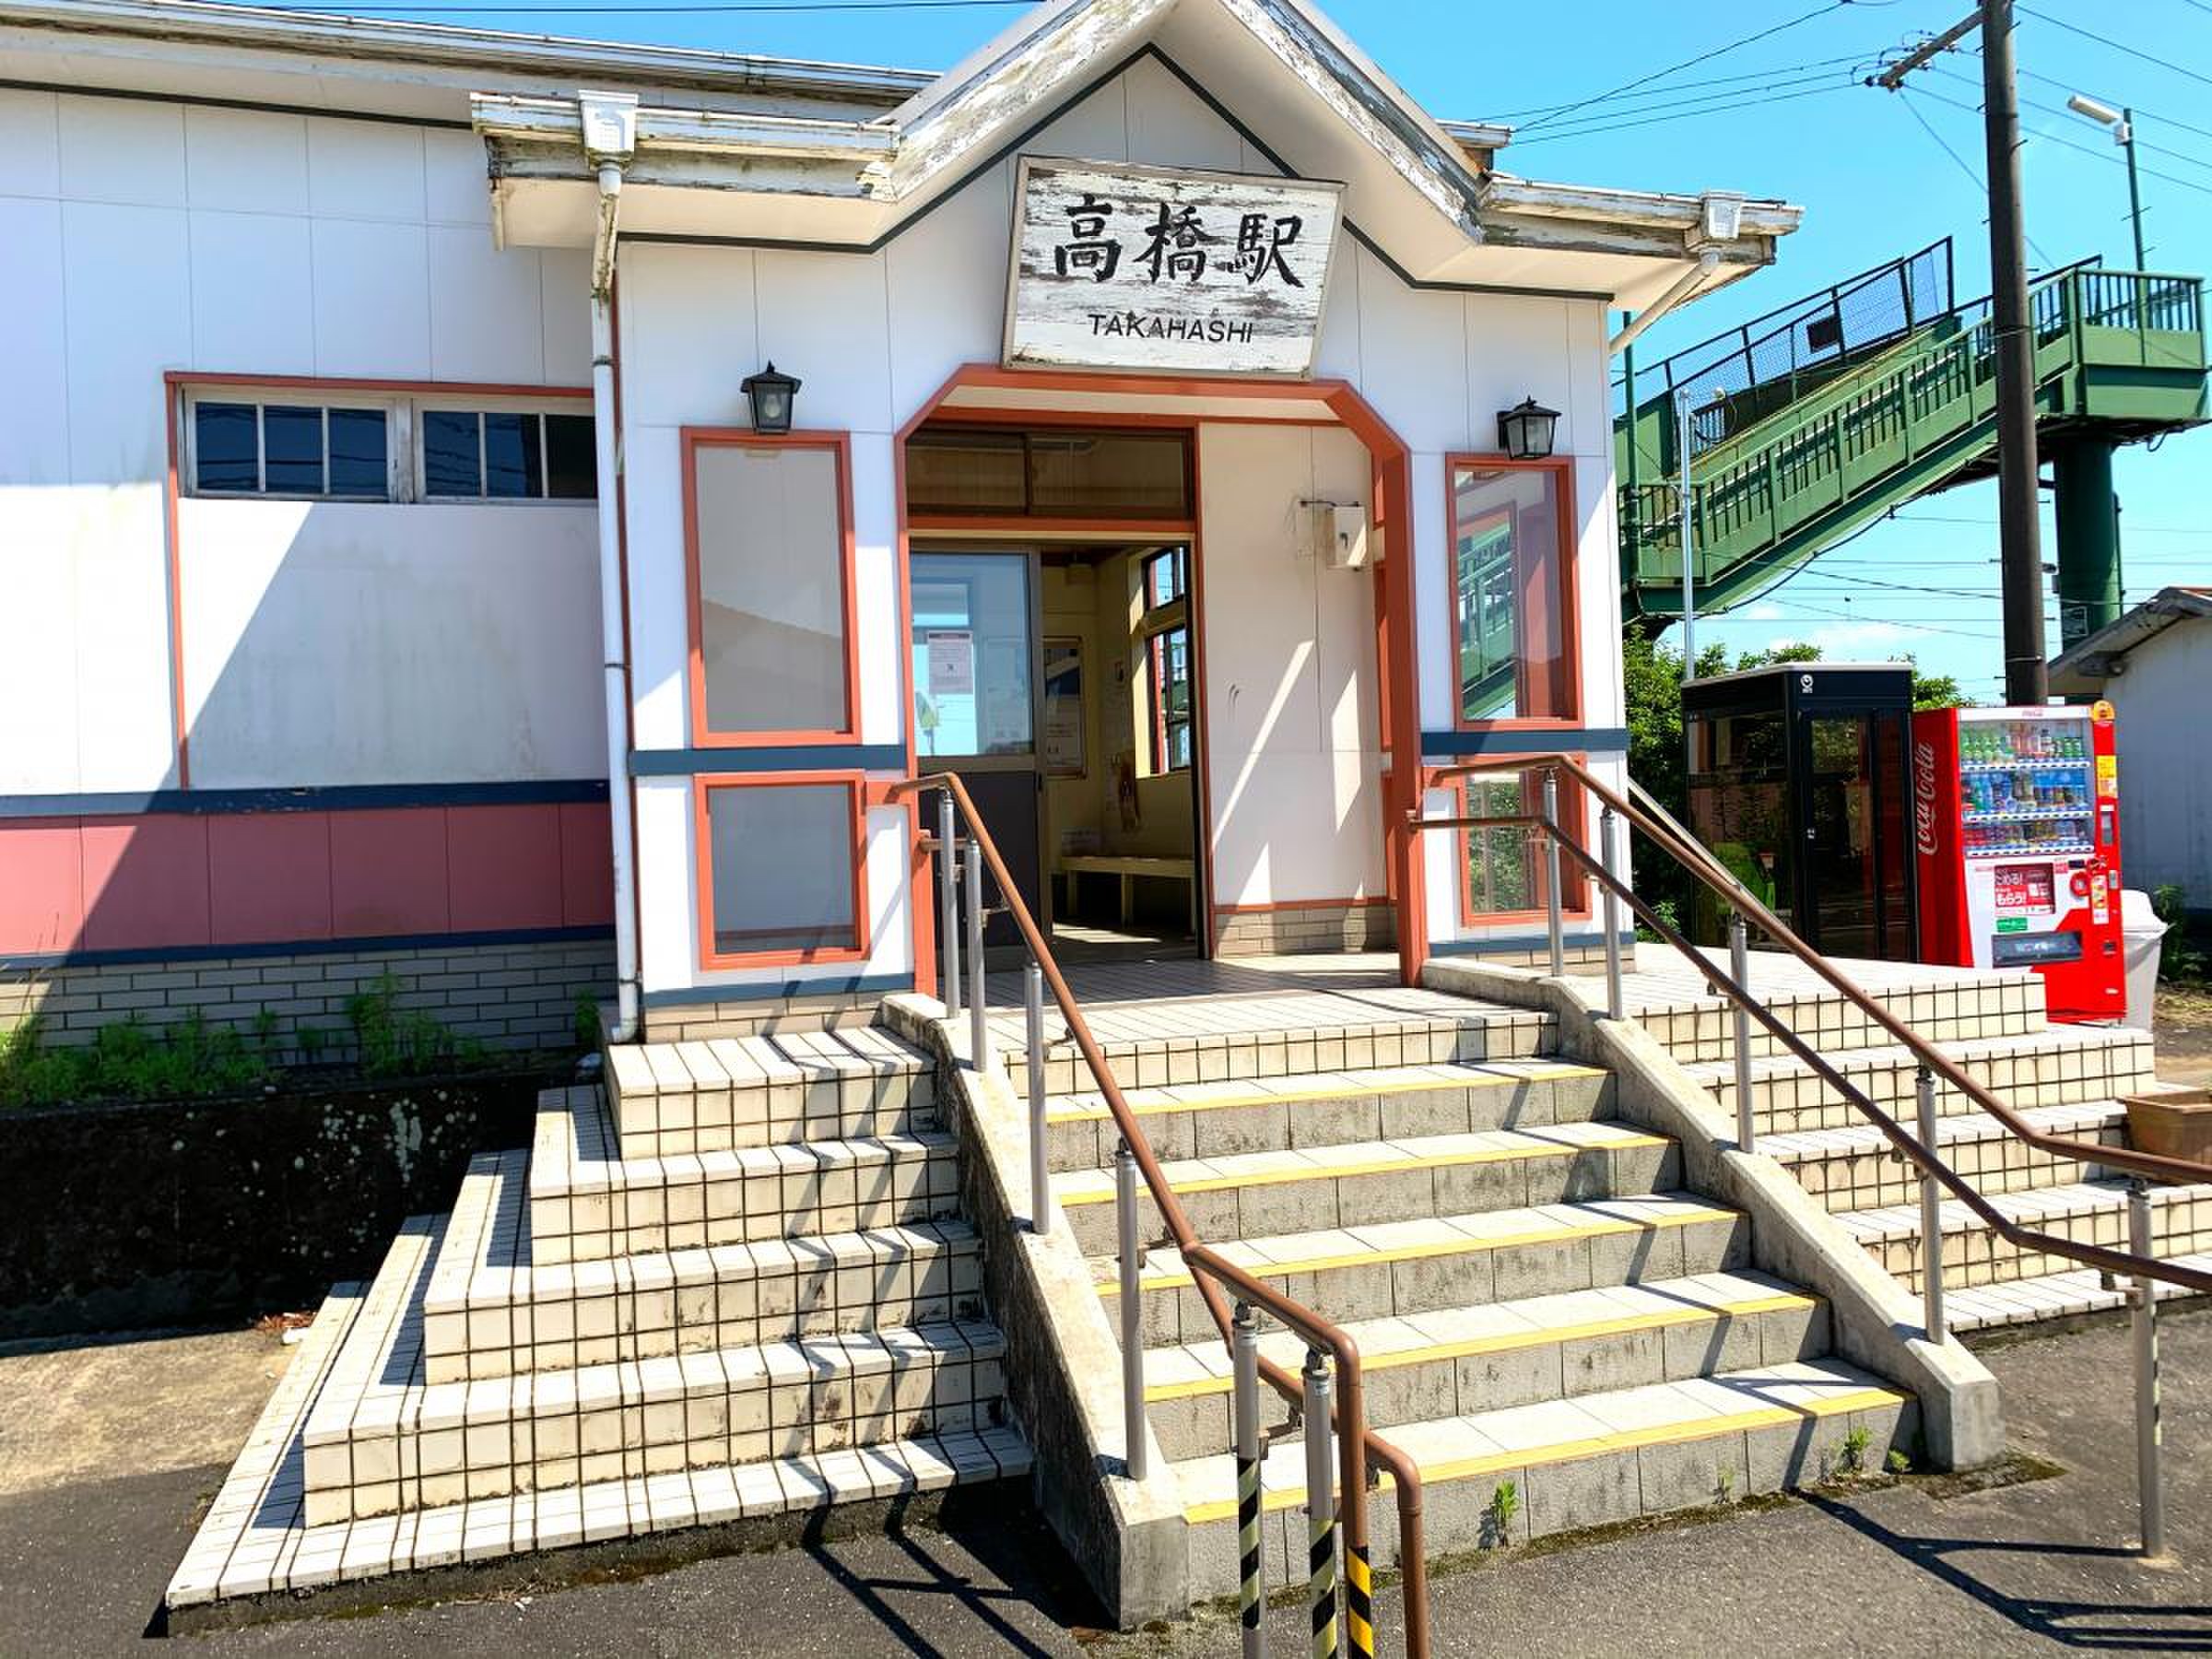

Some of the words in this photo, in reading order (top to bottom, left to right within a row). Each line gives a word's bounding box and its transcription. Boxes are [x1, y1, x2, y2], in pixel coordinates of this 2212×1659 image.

[1054, 194, 1305, 288] 高橋駅
[1088, 313, 1253, 344] TAKAHASHI
